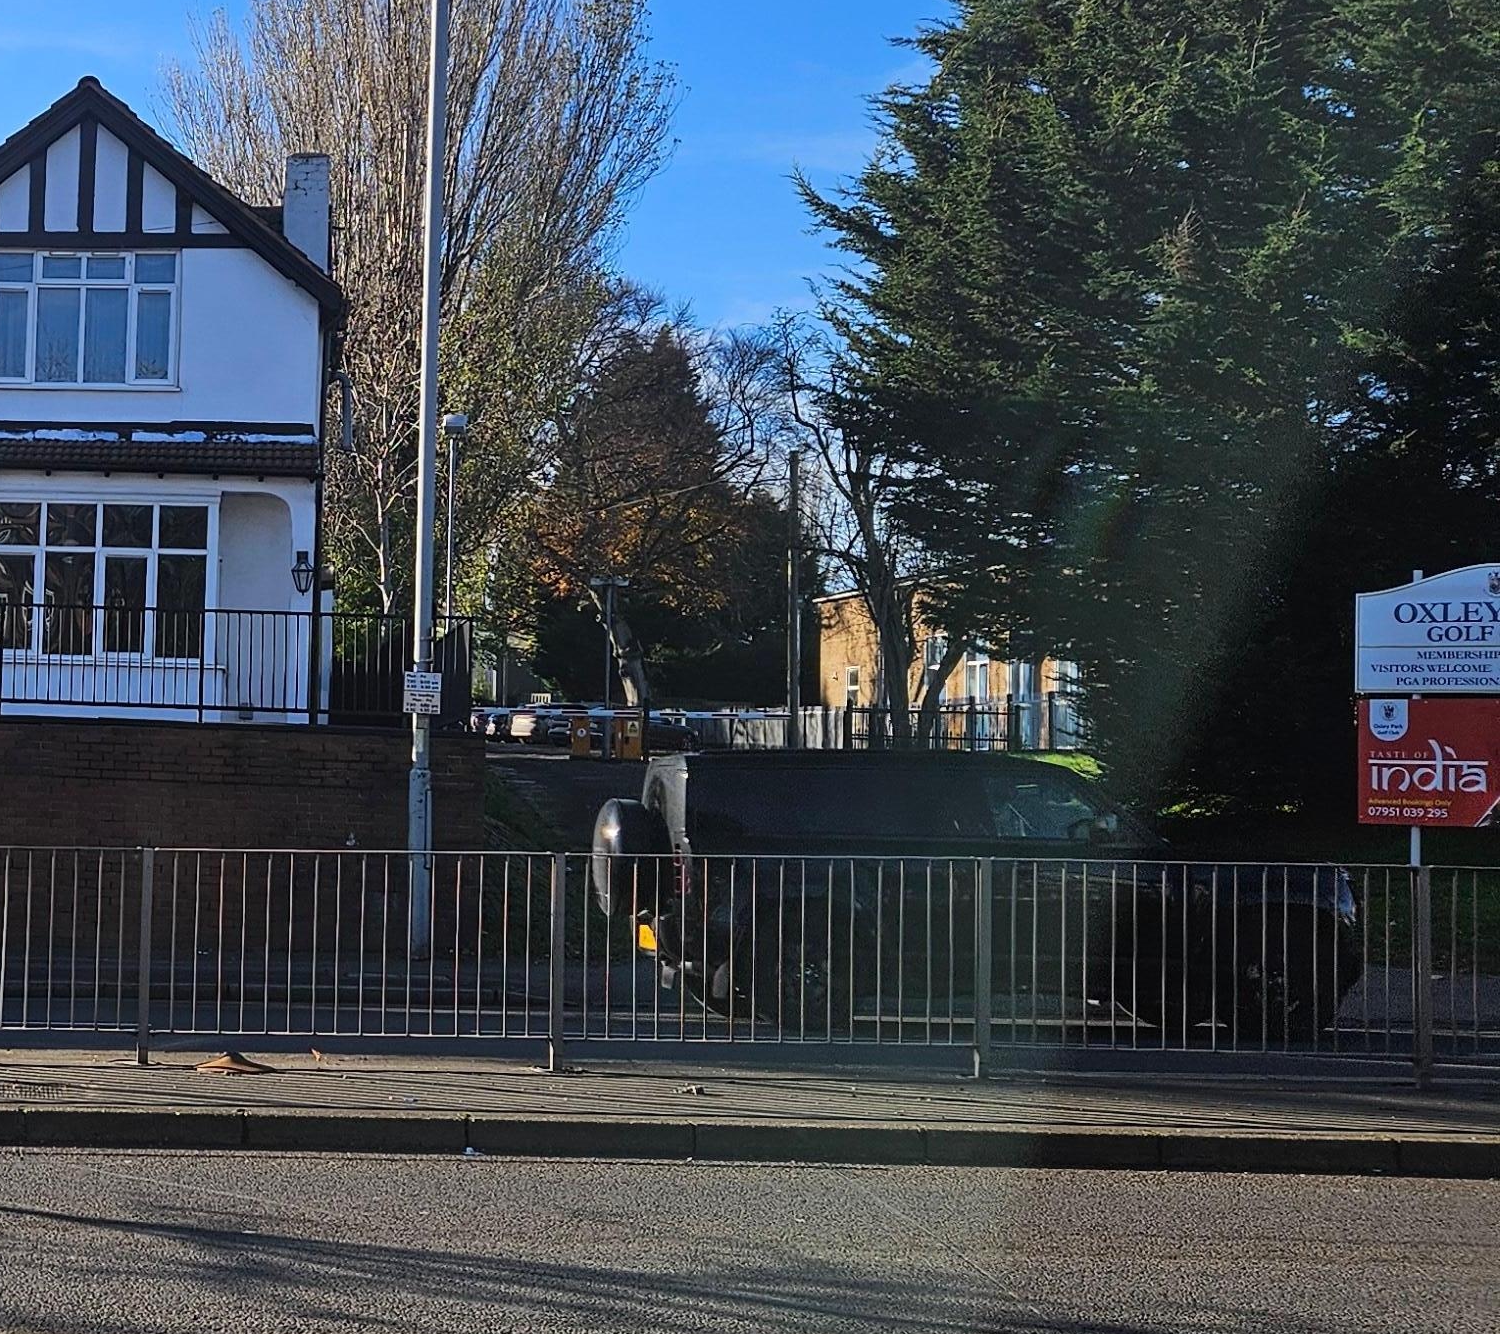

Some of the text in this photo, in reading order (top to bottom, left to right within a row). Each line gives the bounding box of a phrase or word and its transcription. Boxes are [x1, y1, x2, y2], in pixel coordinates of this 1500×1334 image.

[1394, 602, 1500, 623] OXLEY
[1427, 626, 1494, 642] GOLF
[1371, 664, 1493, 673] VISITORS WELCOME
[1396, 677, 1420, 685] PGA
[1402, 798, 1434, 806] Bookings
[1435, 799, 1452, 807] Only
[1368, 807, 1448, 818] 07951 039 295
